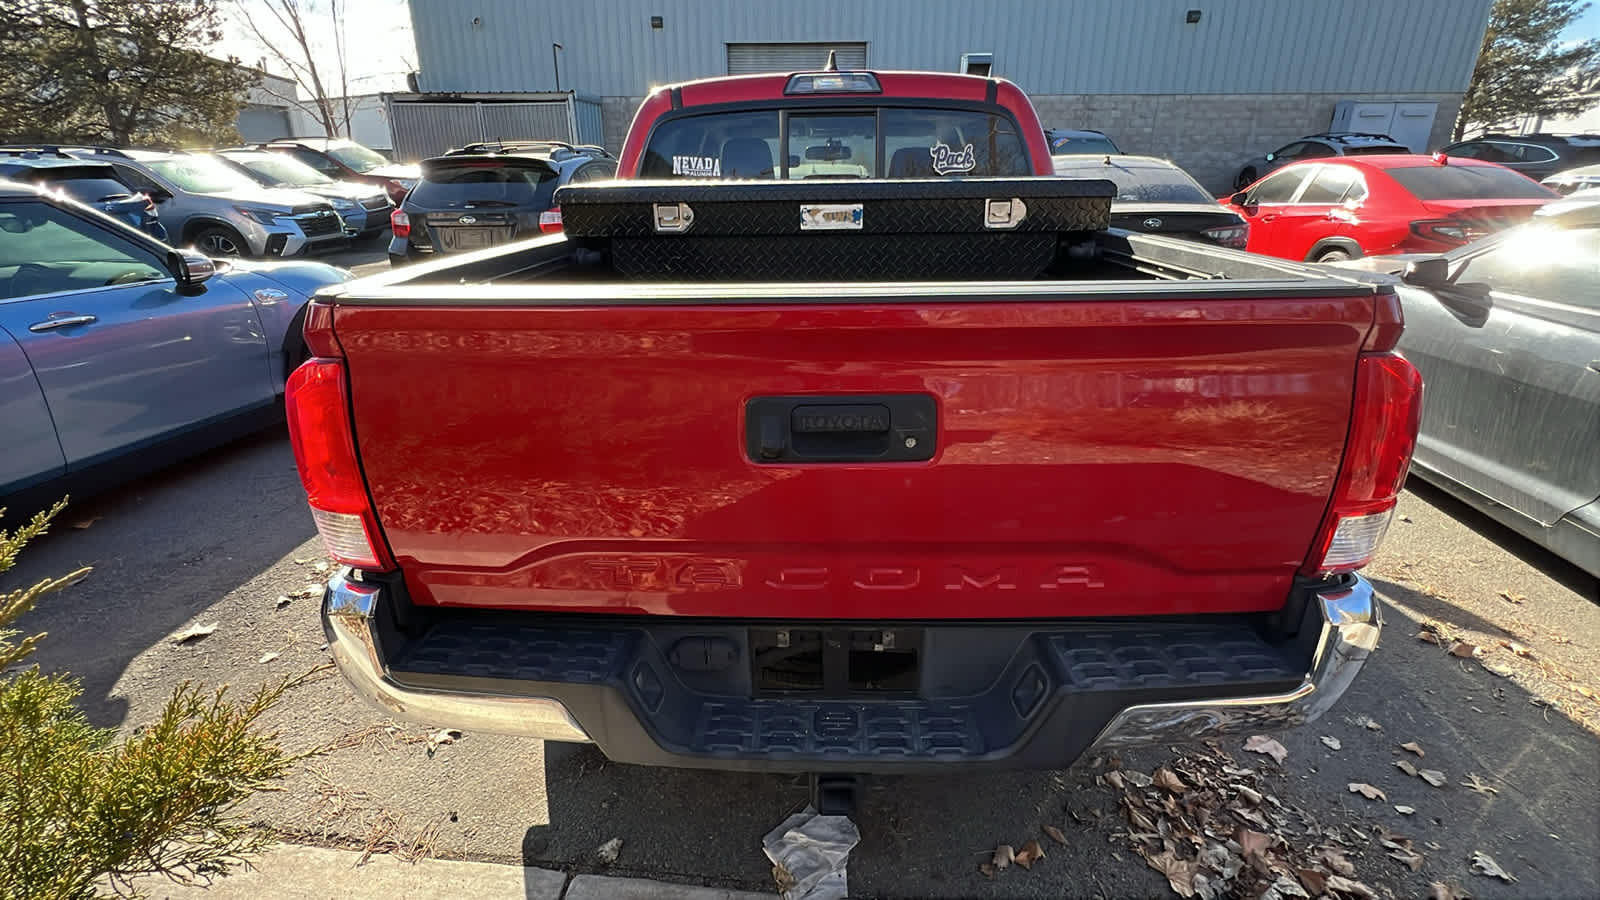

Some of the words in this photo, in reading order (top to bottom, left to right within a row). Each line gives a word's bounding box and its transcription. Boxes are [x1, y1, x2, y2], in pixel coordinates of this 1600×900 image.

[672, 155, 721, 177] NEVADA
[930, 143, 976, 175] Pack
[797, 415, 886, 432] TOYOTA
[584, 558, 1105, 591] TACOMA
